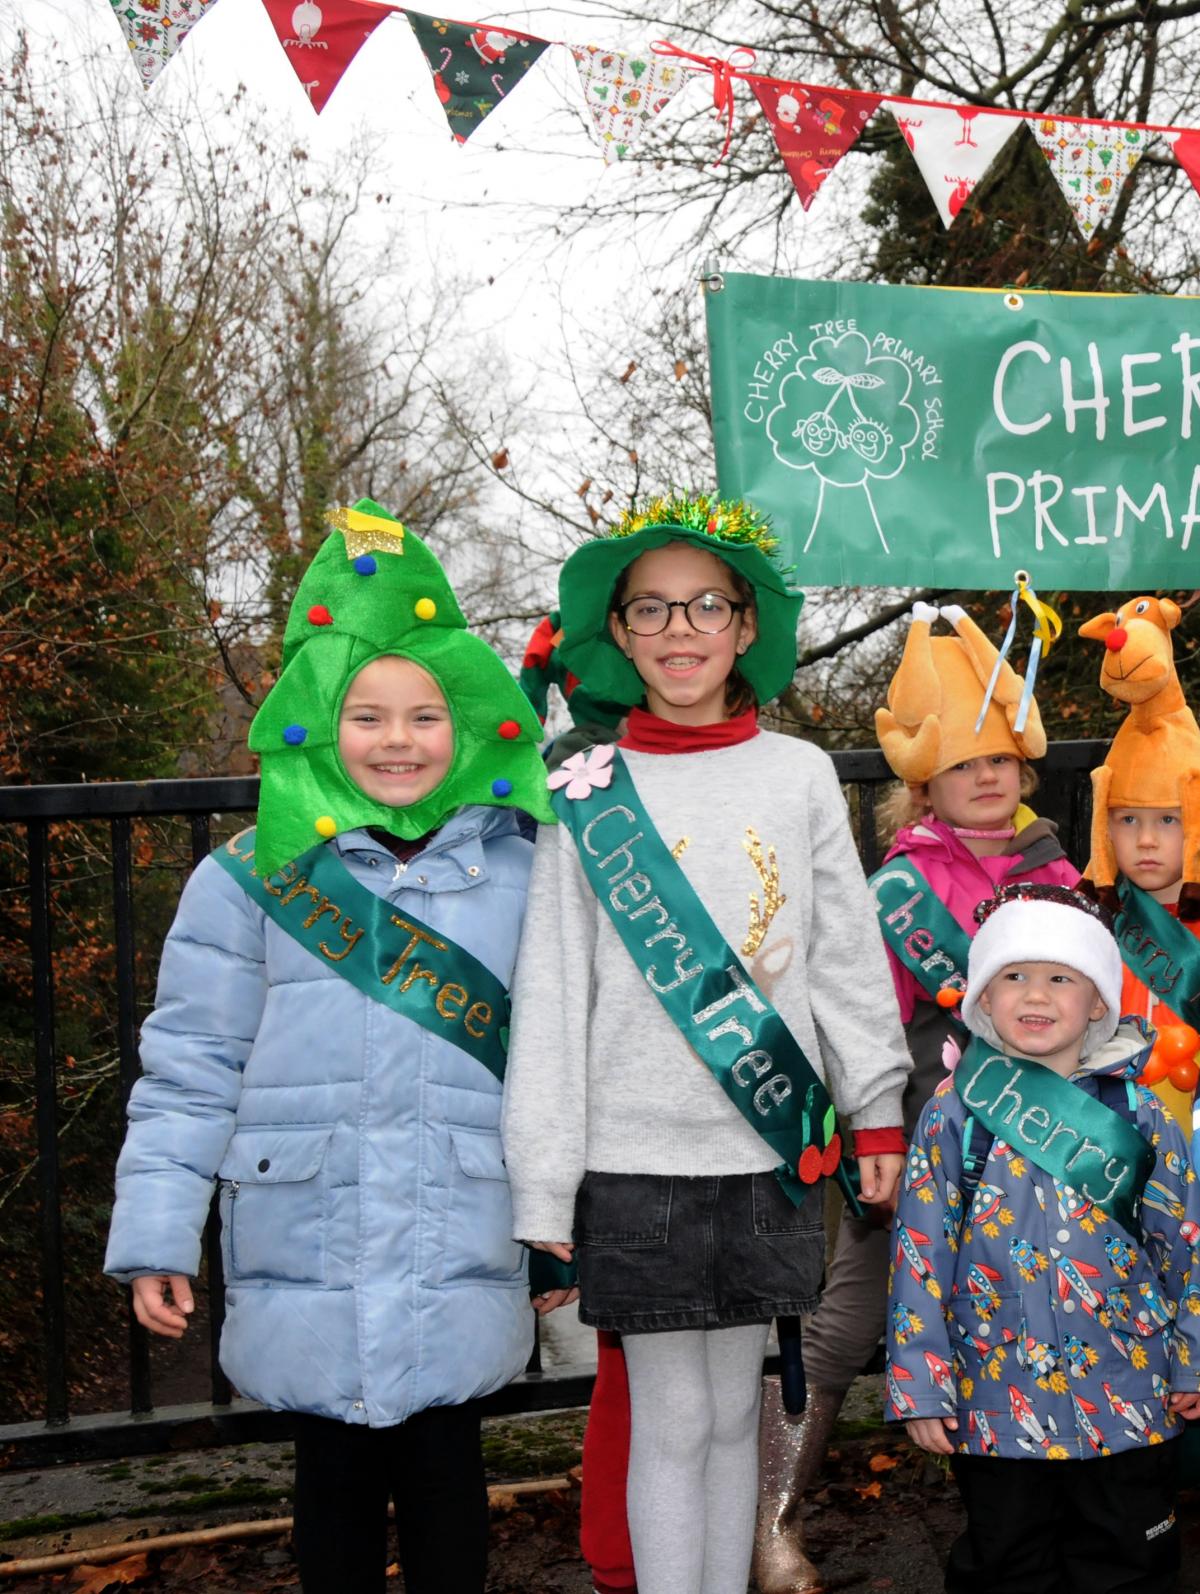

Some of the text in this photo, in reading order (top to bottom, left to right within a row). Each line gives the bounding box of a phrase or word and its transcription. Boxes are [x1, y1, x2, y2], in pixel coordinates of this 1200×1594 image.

[744, 332, 800, 423] CHERRY
[809, 318, 858, 338] TREE
[873, 331, 943, 386] PRIMARY
[381, 914, 493, 1038] Tree
[582, 804, 793, 1117] Cherry Tree
[962, 1055, 1130, 1205] Cherry
